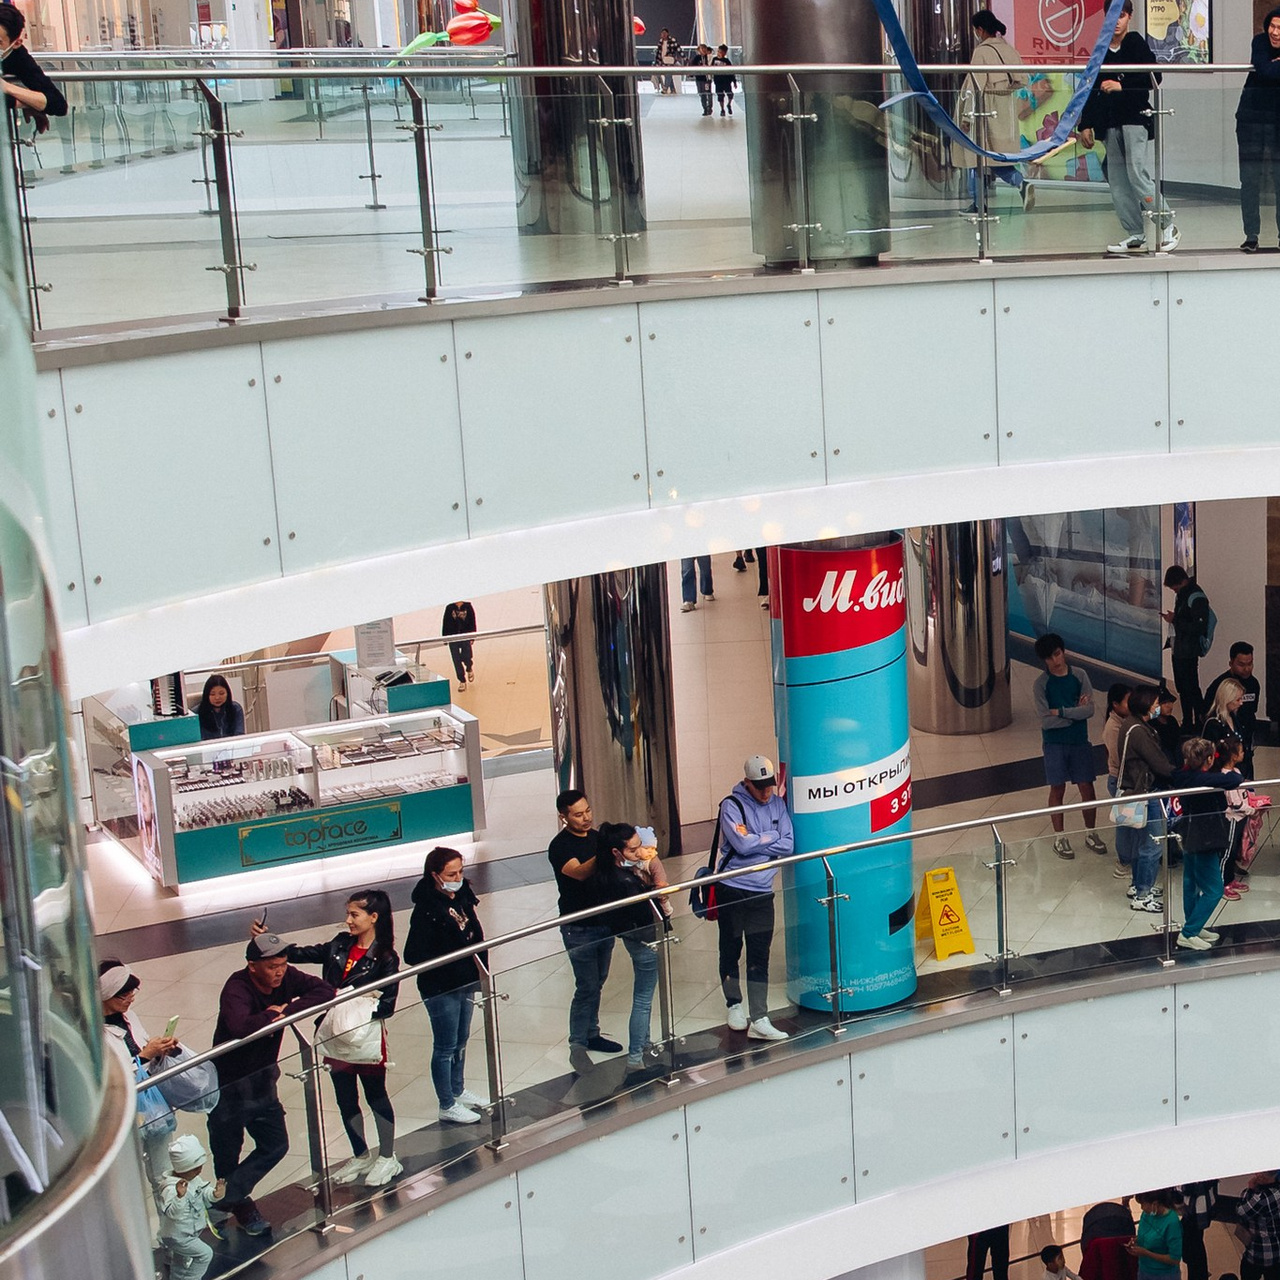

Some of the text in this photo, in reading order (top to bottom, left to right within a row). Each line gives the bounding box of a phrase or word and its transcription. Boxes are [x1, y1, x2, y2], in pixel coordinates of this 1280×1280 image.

[1150, 5, 1165, 13] УТРО
[808, 753, 910, 800] МЫ ОТКРЫЛ
[890, 798, 899, 814] 3
